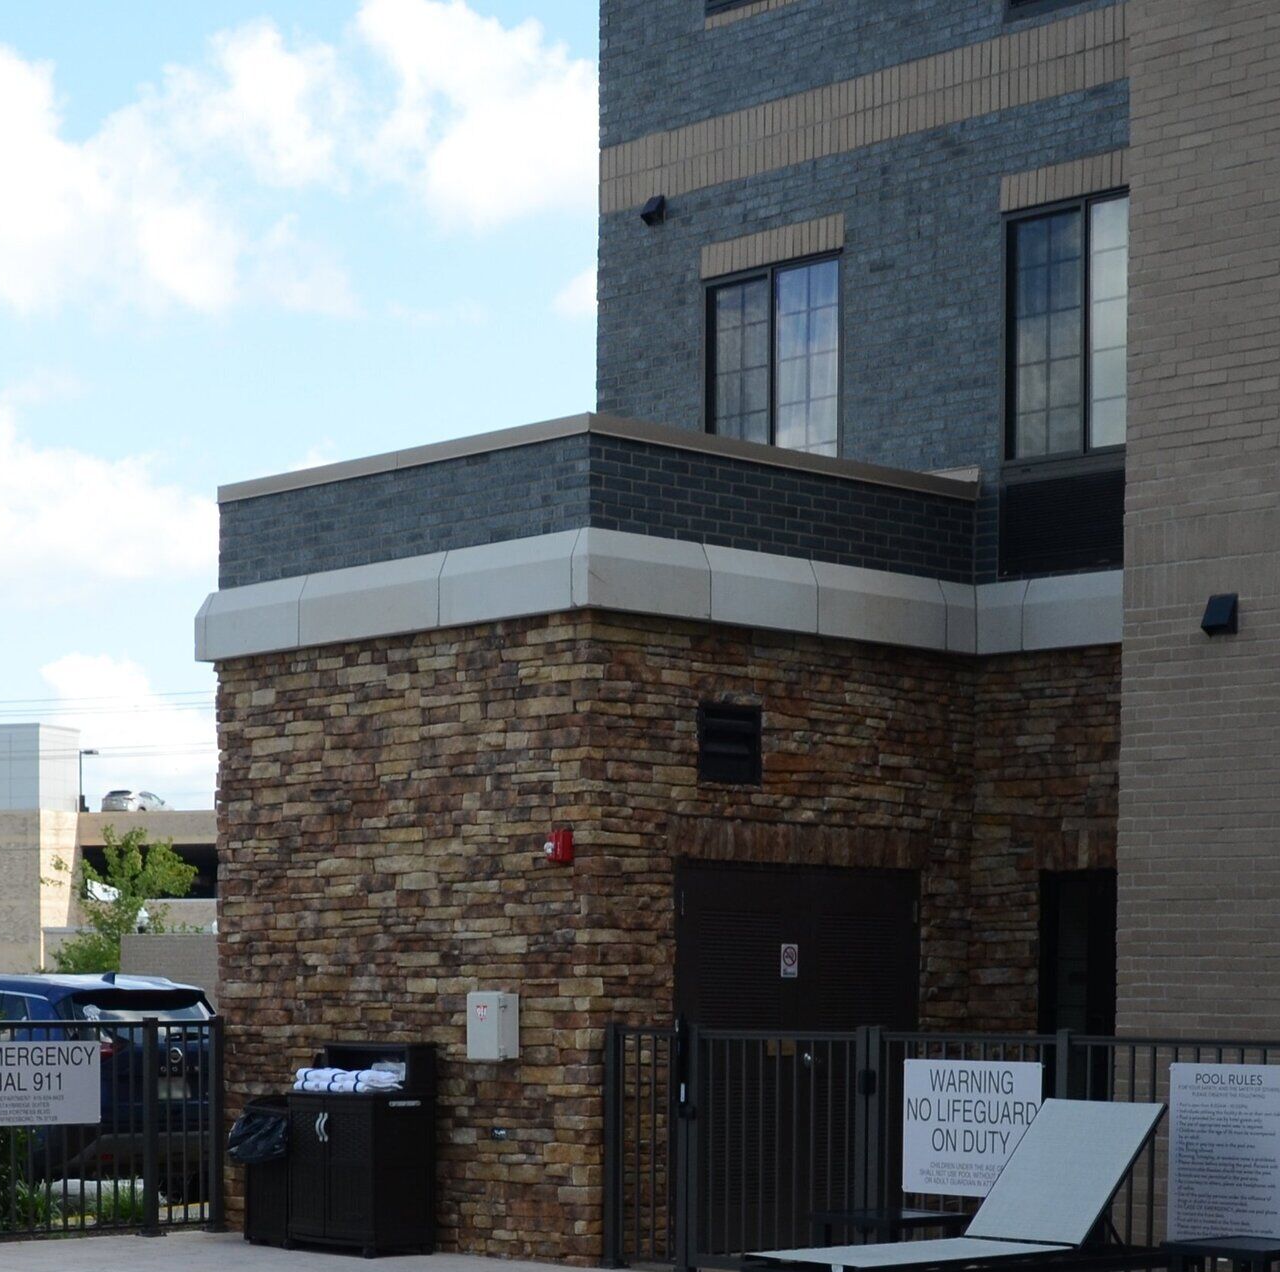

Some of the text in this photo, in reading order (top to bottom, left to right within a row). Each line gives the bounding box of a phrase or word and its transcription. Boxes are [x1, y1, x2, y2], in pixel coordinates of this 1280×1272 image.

[33, 1071, 63, 1092] 911
[930, 1069, 1014, 1095] WARNING
[1195, 1073, 1263, 1086] POOL RULES
[907, 1097, 1039, 1125] NO LIFEGUARD
[932, 1128, 1011, 1154] ON DUTY
